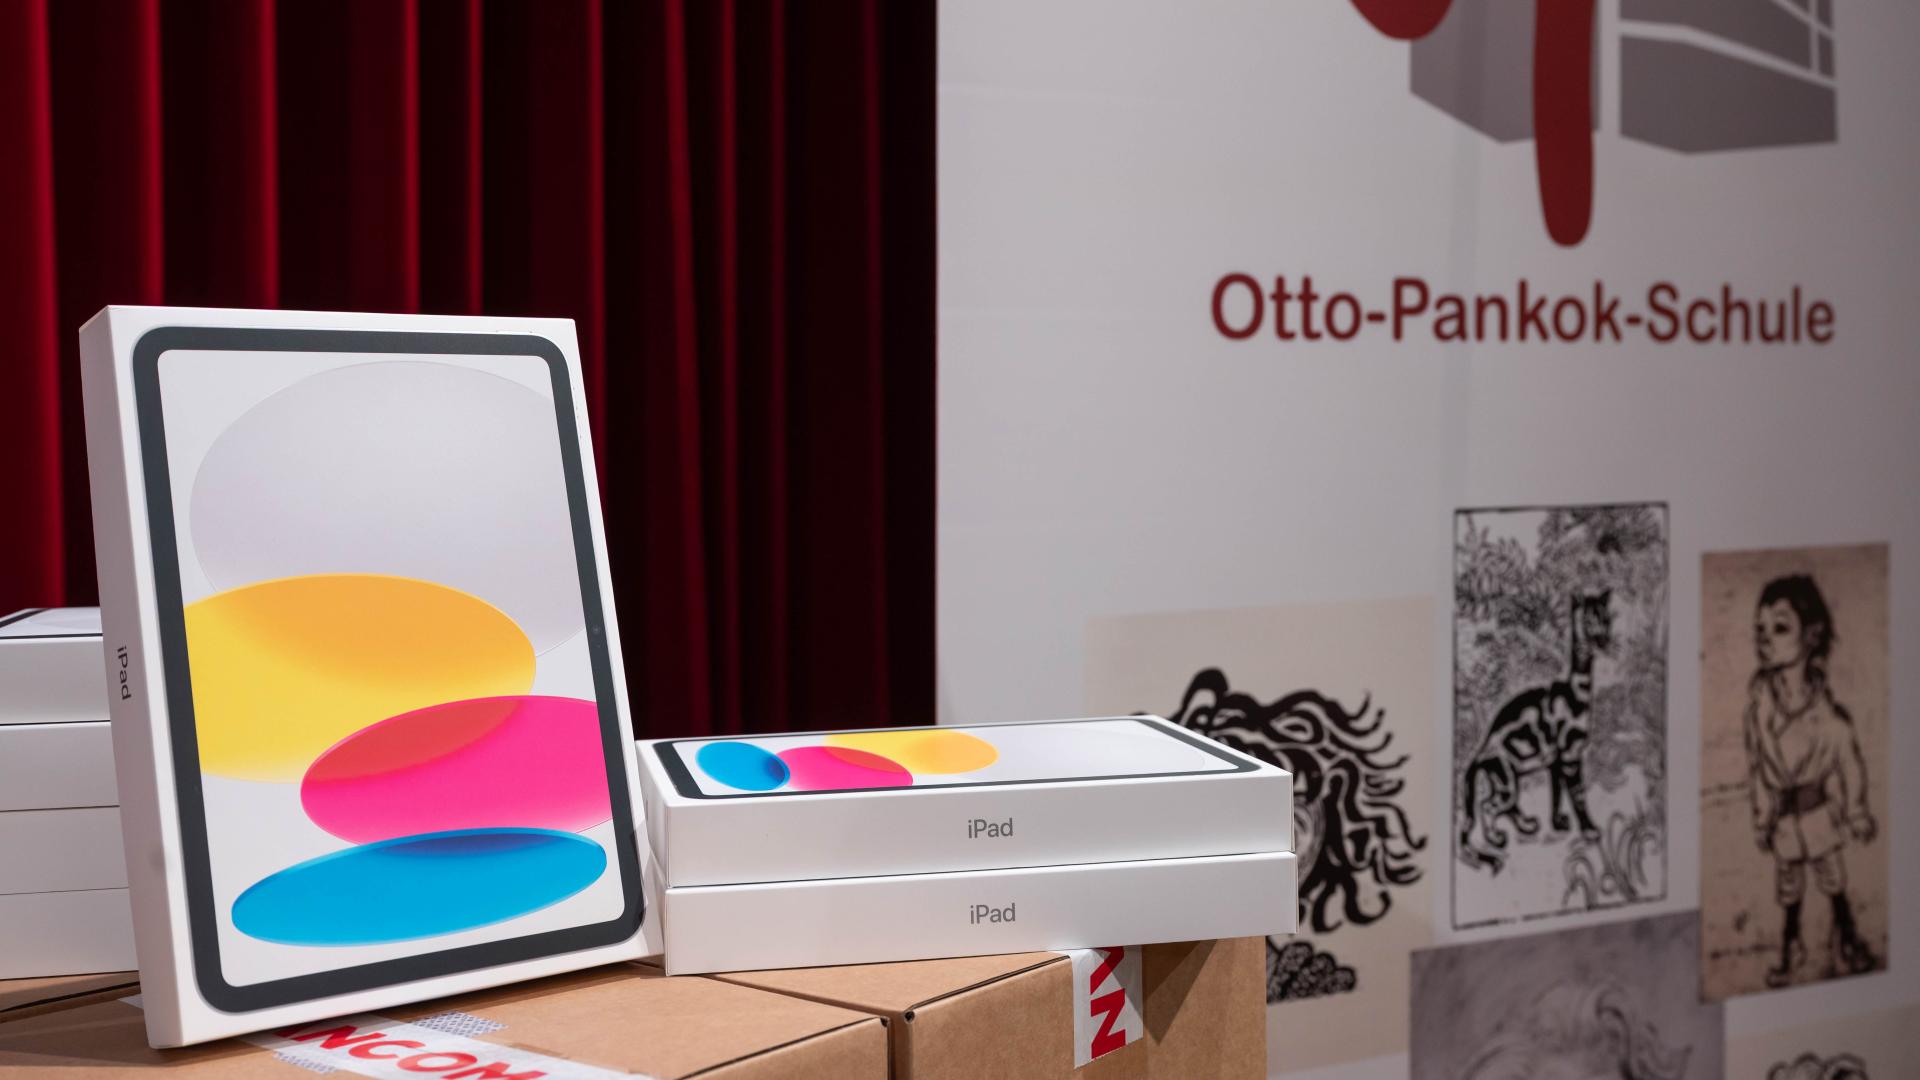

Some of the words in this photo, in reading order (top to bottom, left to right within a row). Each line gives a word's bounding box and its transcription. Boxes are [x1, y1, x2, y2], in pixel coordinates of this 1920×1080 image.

[1211, 273, 1836, 343] Otto-Pankok-Schule
[117, 645, 132, 700] iPad
[968, 817, 1014, 839] iPad
[970, 902, 1016, 925] iPad
